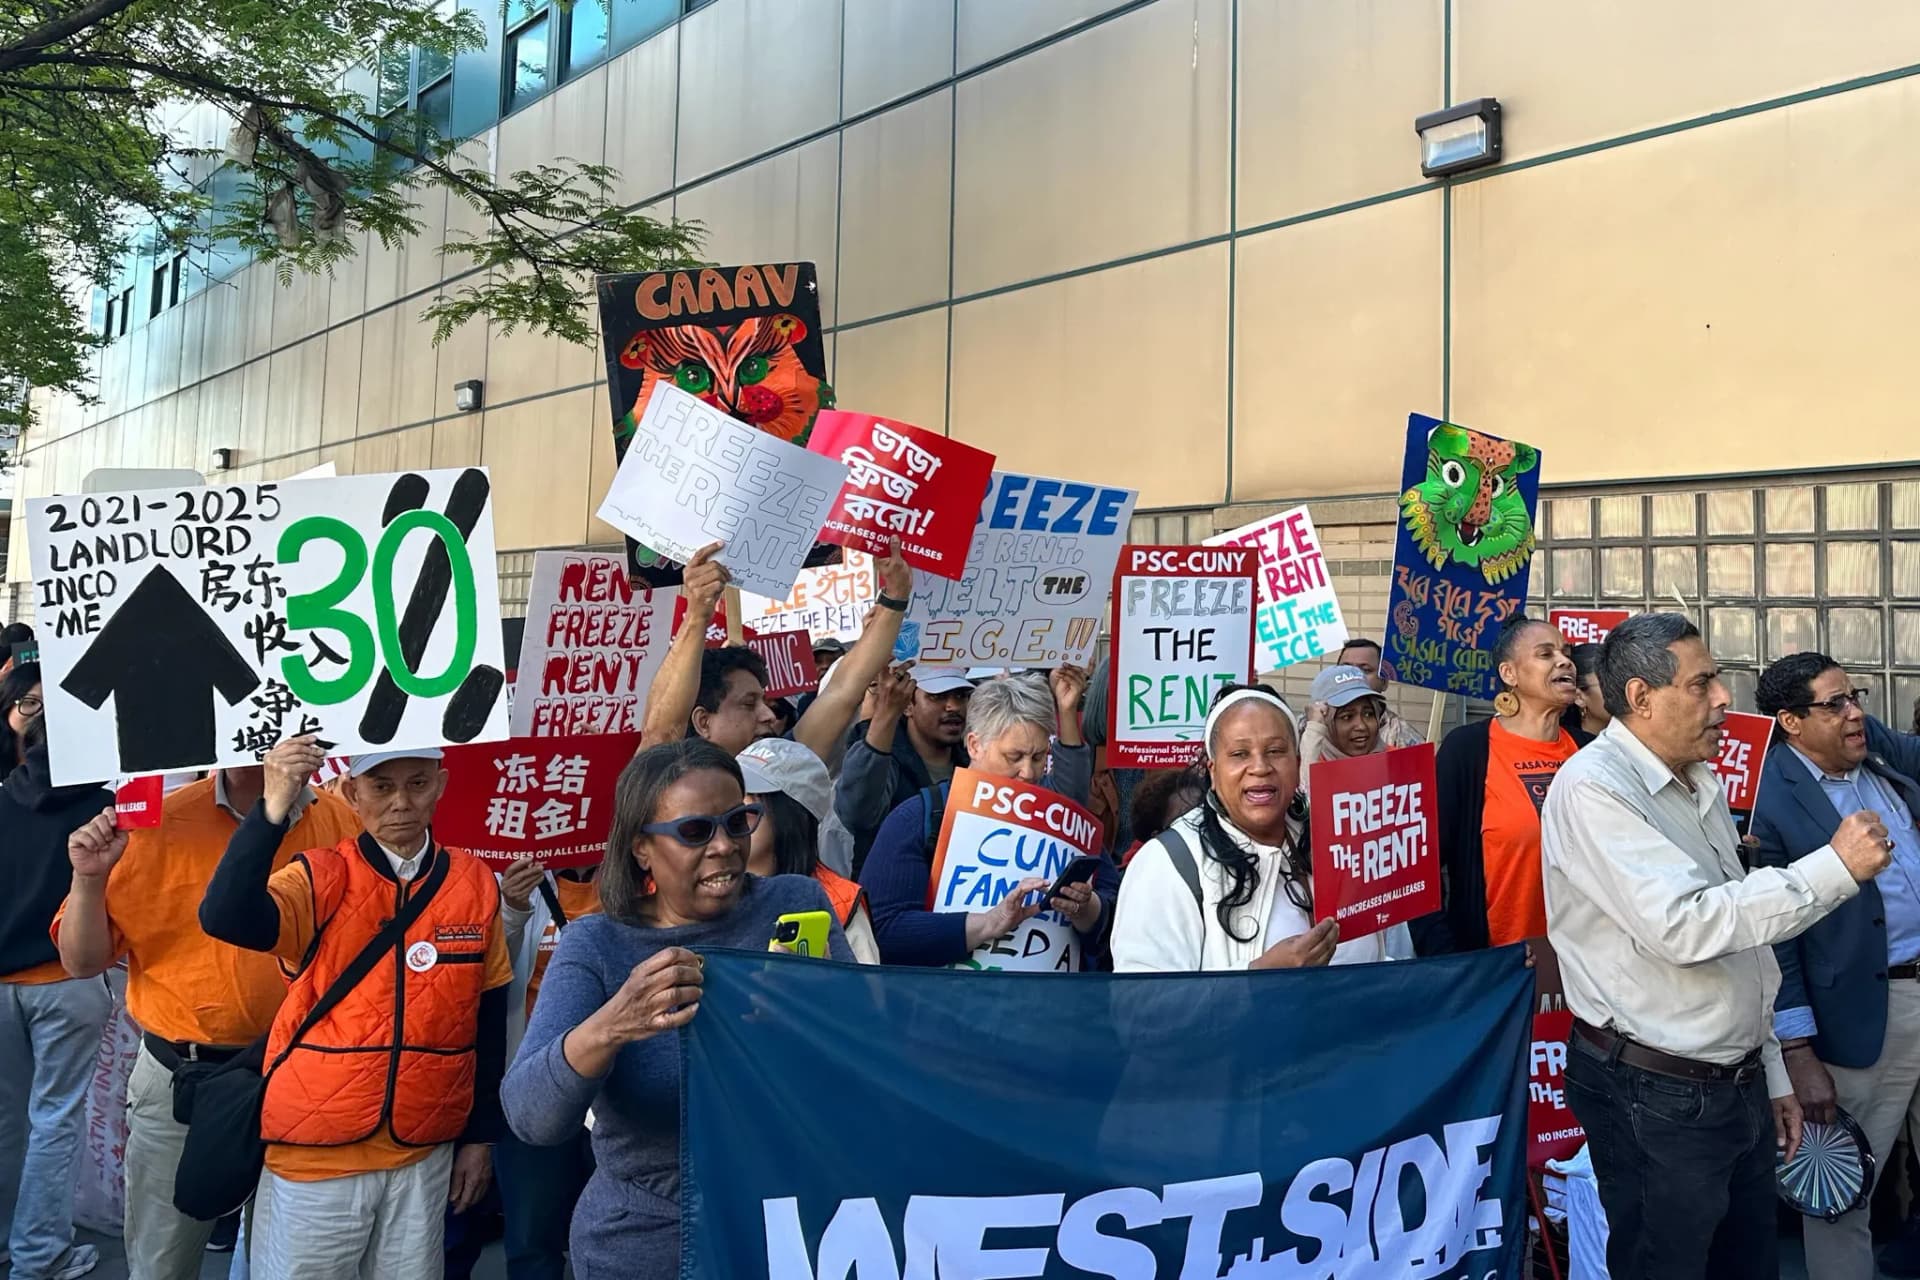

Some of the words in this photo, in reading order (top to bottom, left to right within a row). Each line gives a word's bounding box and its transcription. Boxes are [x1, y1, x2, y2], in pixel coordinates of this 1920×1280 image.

[635, 264, 798, 320] CAAAV
[634, 430, 684, 484] THE
[653, 387, 828, 530] FREEZE
[872, 423, 942, 481] ভাড়া
[841, 446, 919, 504] ফ্রিজ
[45, 484, 281, 532] 2021-2025
[676, 464, 817, 569] RENT!
[844, 493, 934, 536] করো!
[976, 475, 1128, 536] EEZE
[50, 525, 251, 571] LANDLORD
[823, 519, 876, 540] NCREASES
[877, 534, 890, 545] ON
[908, 545, 943, 561] LEASES
[994, 534, 1083, 564] RENT,
[199, 553, 287, 612] 房东
[1131, 551, 1247, 573] PSC-CUNY
[1264, 552, 1326, 602] RENT
[37, 570, 117, 607] INCO
[1043, 576, 1085, 595] THE
[1127, 579, 1248, 620] FREEZE
[244, 611, 349, 667] 收入
[547, 604, 653, 649] FREEZE
[744, 613, 788, 634] EEZE
[794, 608, 821, 630] THE
[1256, 599, 1298, 643] ELT
[1299, 601, 1337, 628] THE
[1558, 616, 1609, 643] FREEZ
[1143, 628, 1217, 662] THE
[1268, 629, 1324, 669] ICE
[542, 649, 647, 696] RENT
[530, 695, 637, 736] FREEZE
[1119, 745, 1169, 754] Professional
[1171, 745, 1191, 754] Staff
[1137, 755, 1154, 764] AFT
[1155, 755, 1177, 764] Local
[1514, 760, 1540, 770] CASA
[493, 753, 590, 794] 冻结
[1708, 762, 1750, 803] NT!
[485, 797, 592, 840] 租金!
[972, 780, 1097, 849] PSC-CUNY
[1332, 783, 1423, 836] FREEZE
[474, 851, 533, 861] INCREASES
[536, 850, 552, 859] ON
[554, 848, 573, 857] ALL
[575, 842, 609, 854] LEASE
[977, 828, 1075, 880] CUN
[1329, 844, 1360, 878] THE
[1363, 817, 1427, 884] RENT!
[1337, 907, 1347, 920] NO
[1347, 894, 1382, 916] INCREASES
[1383, 891, 1393, 904] ON
[1392, 886, 1402, 901] ALL
[1403, 880, 1426, 897] LEASES
[1529, 1082, 1566, 1110] THE
[1538, 1131, 1552, 1143] NO
[1553, 1127, 1586, 1140] INCREA
[762, 1172, 1263, 1280] WEST
[1281, 1114, 1504, 1280] SIDE
